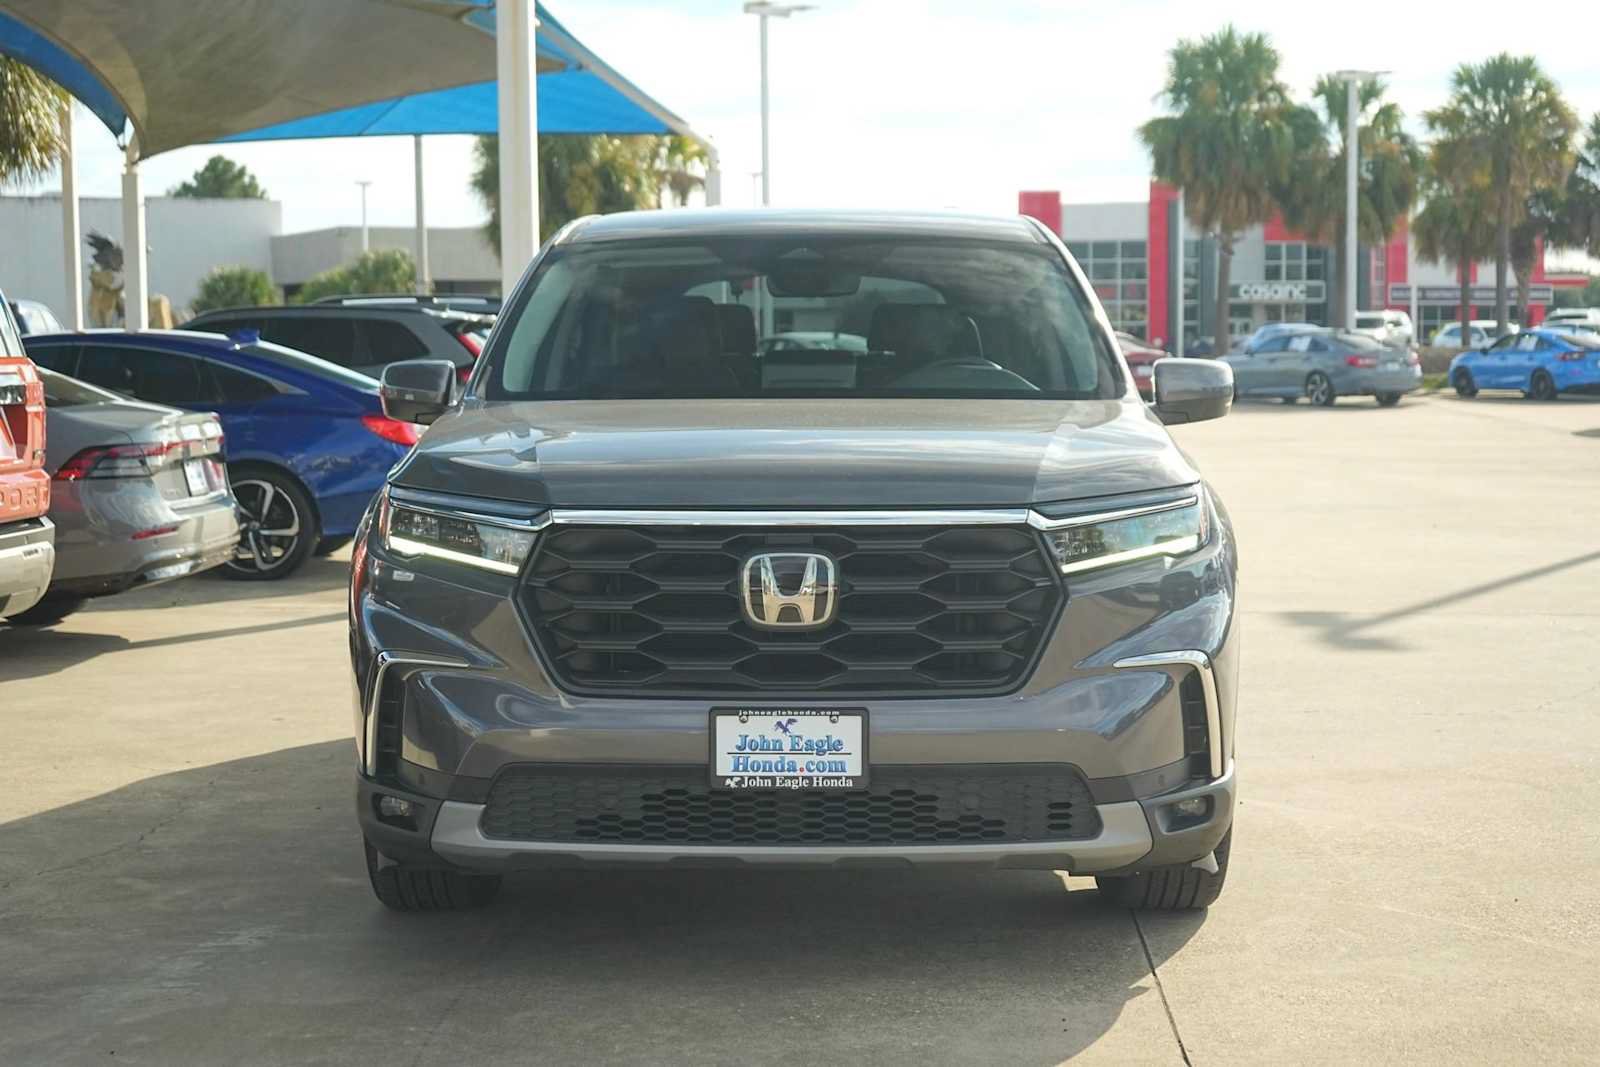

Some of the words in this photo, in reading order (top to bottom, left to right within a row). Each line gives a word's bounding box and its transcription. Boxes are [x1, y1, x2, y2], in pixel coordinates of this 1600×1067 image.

[735, 734, 784, 752] John
[789, 734, 844, 756] Eagle
[732, 756, 847, 773] Honda.com
[742, 776, 772, 788] John
[775, 776, 809, 790] Eagle
[812, 776, 853, 788] Honda
